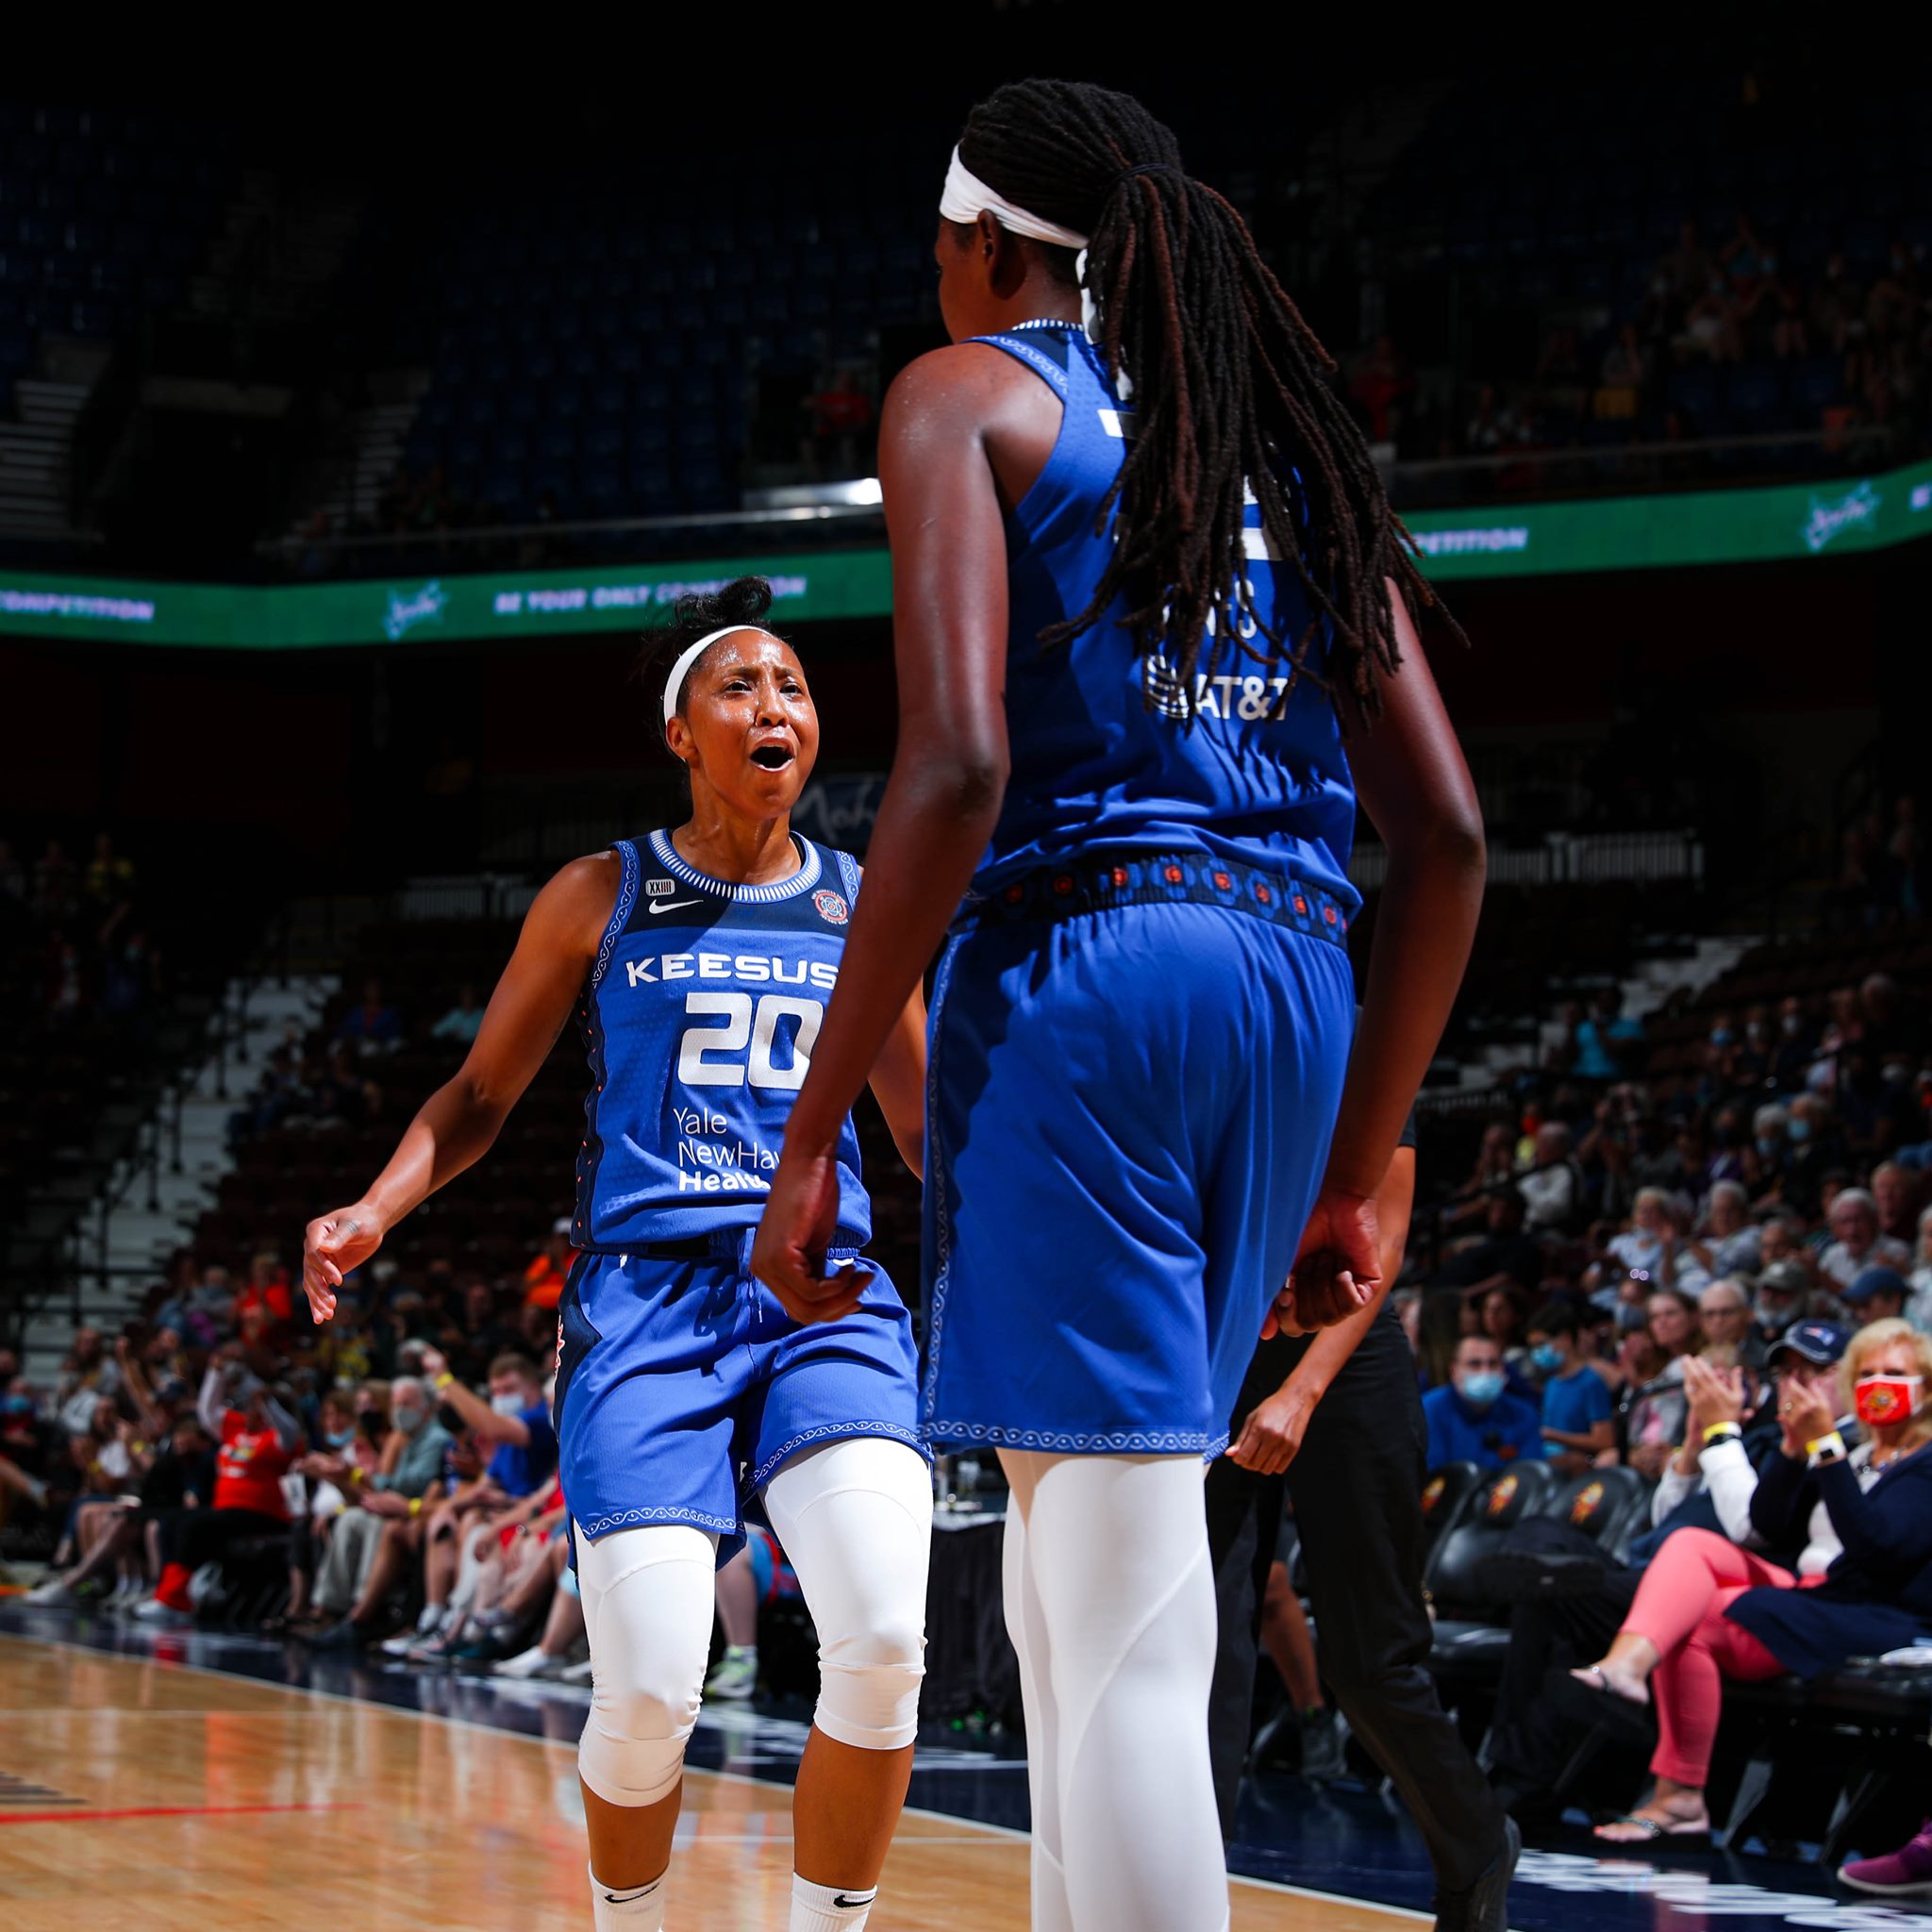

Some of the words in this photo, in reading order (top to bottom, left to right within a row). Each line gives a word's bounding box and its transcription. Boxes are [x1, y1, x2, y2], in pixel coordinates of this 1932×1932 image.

[626, 952, 840, 990] KEESUS
[678, 991, 824, 1091] 20
[673, 1107, 727, 1135] Yale
